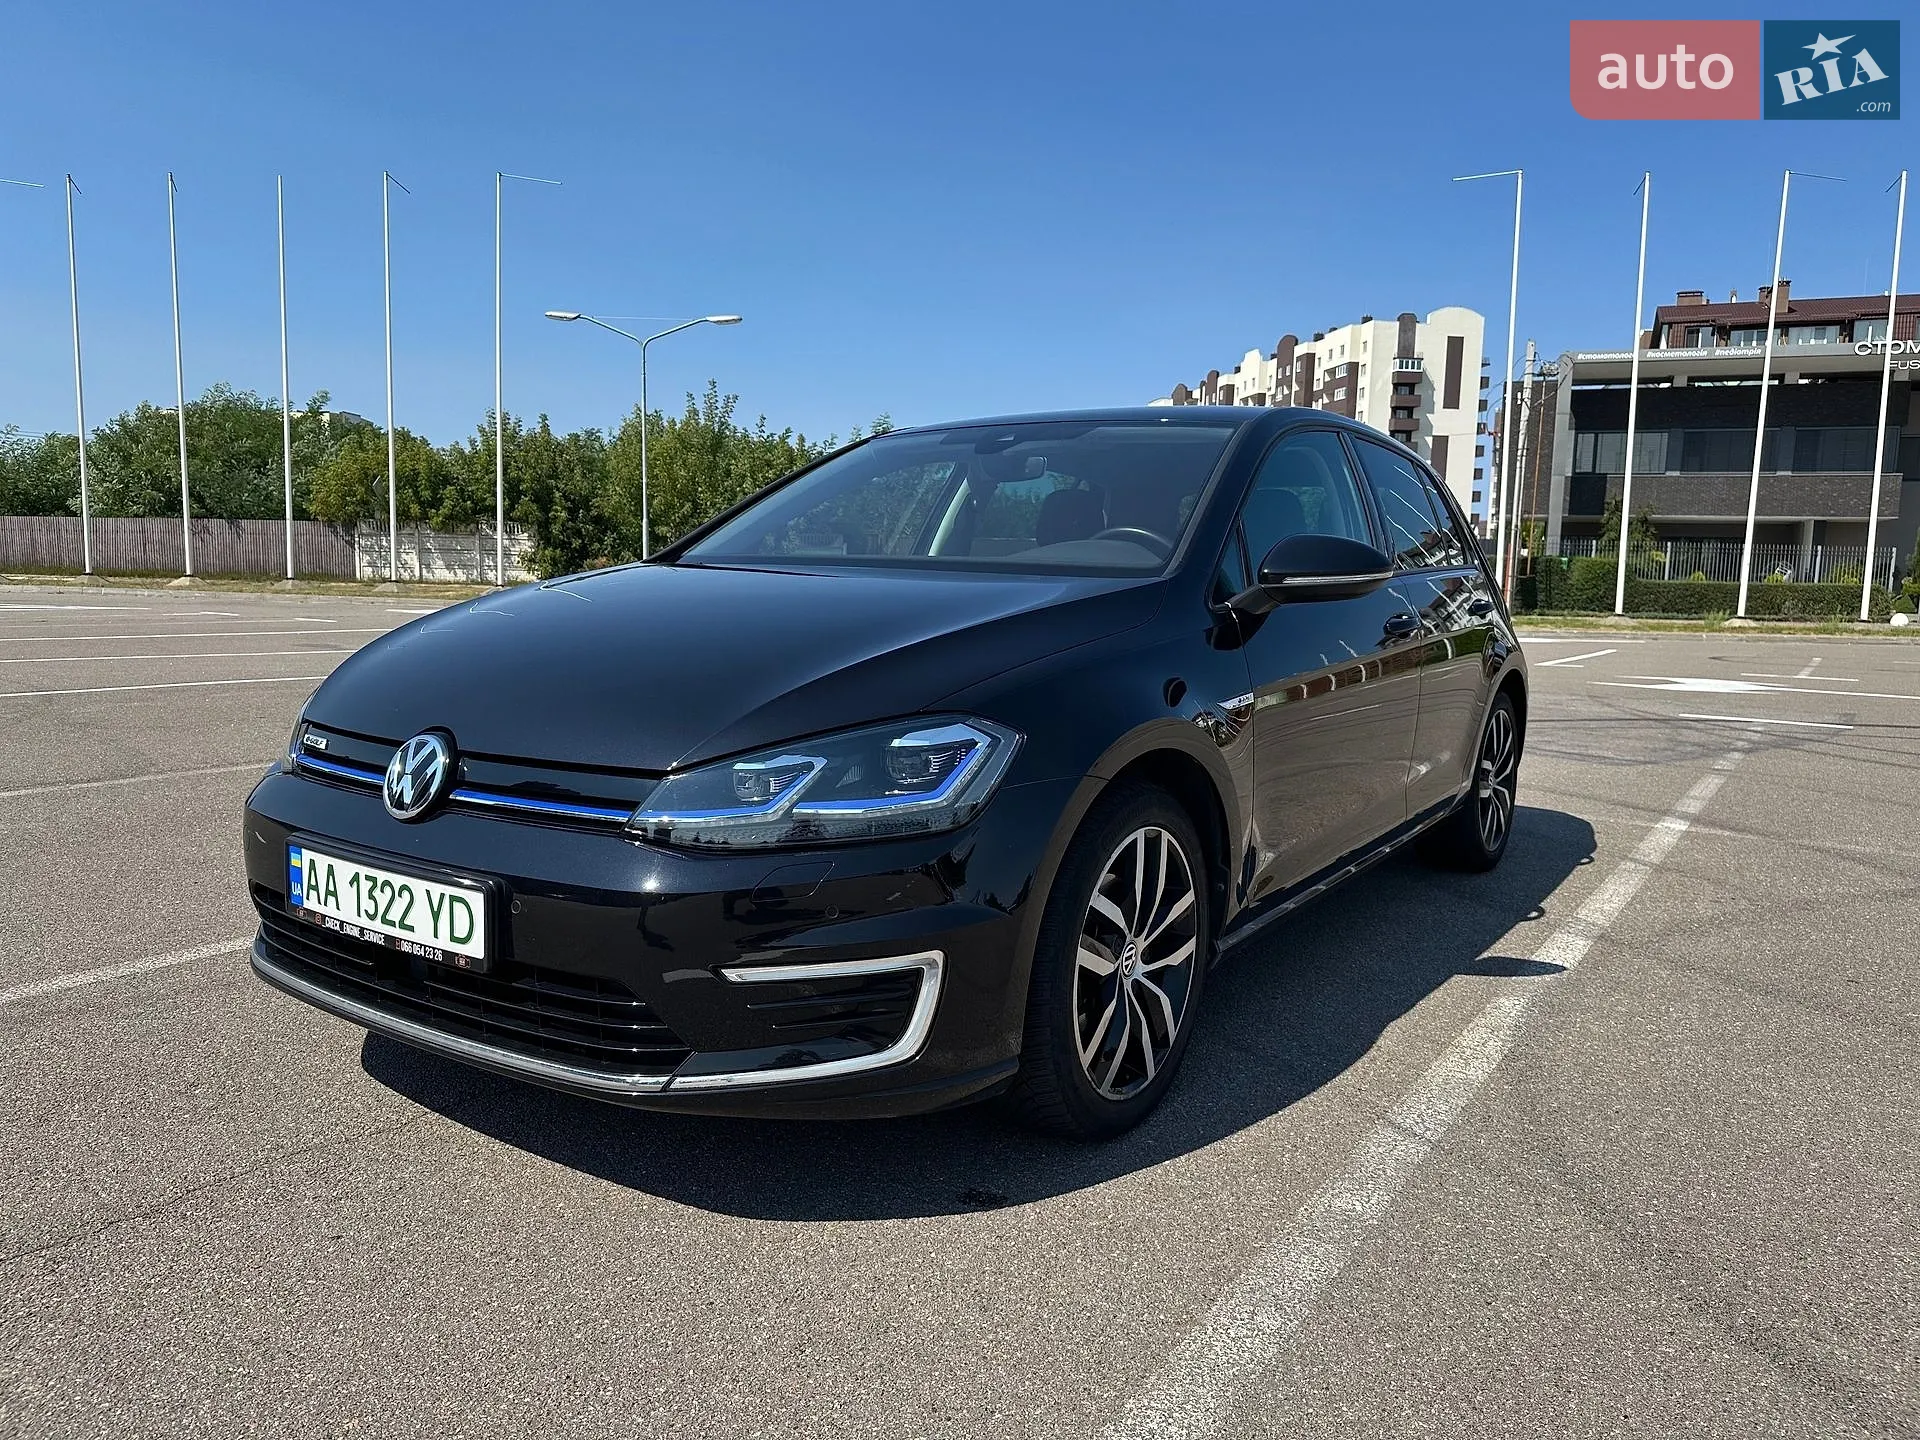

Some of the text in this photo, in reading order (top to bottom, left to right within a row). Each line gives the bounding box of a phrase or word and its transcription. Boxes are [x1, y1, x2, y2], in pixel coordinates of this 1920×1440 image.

[291, 881, 303, 897] UA
[306, 858, 475, 946] AA 1322 YD
[412, 943, 425, 957] 054
[425, 946, 434, 959] 23
[434, 948, 443, 962] 26
